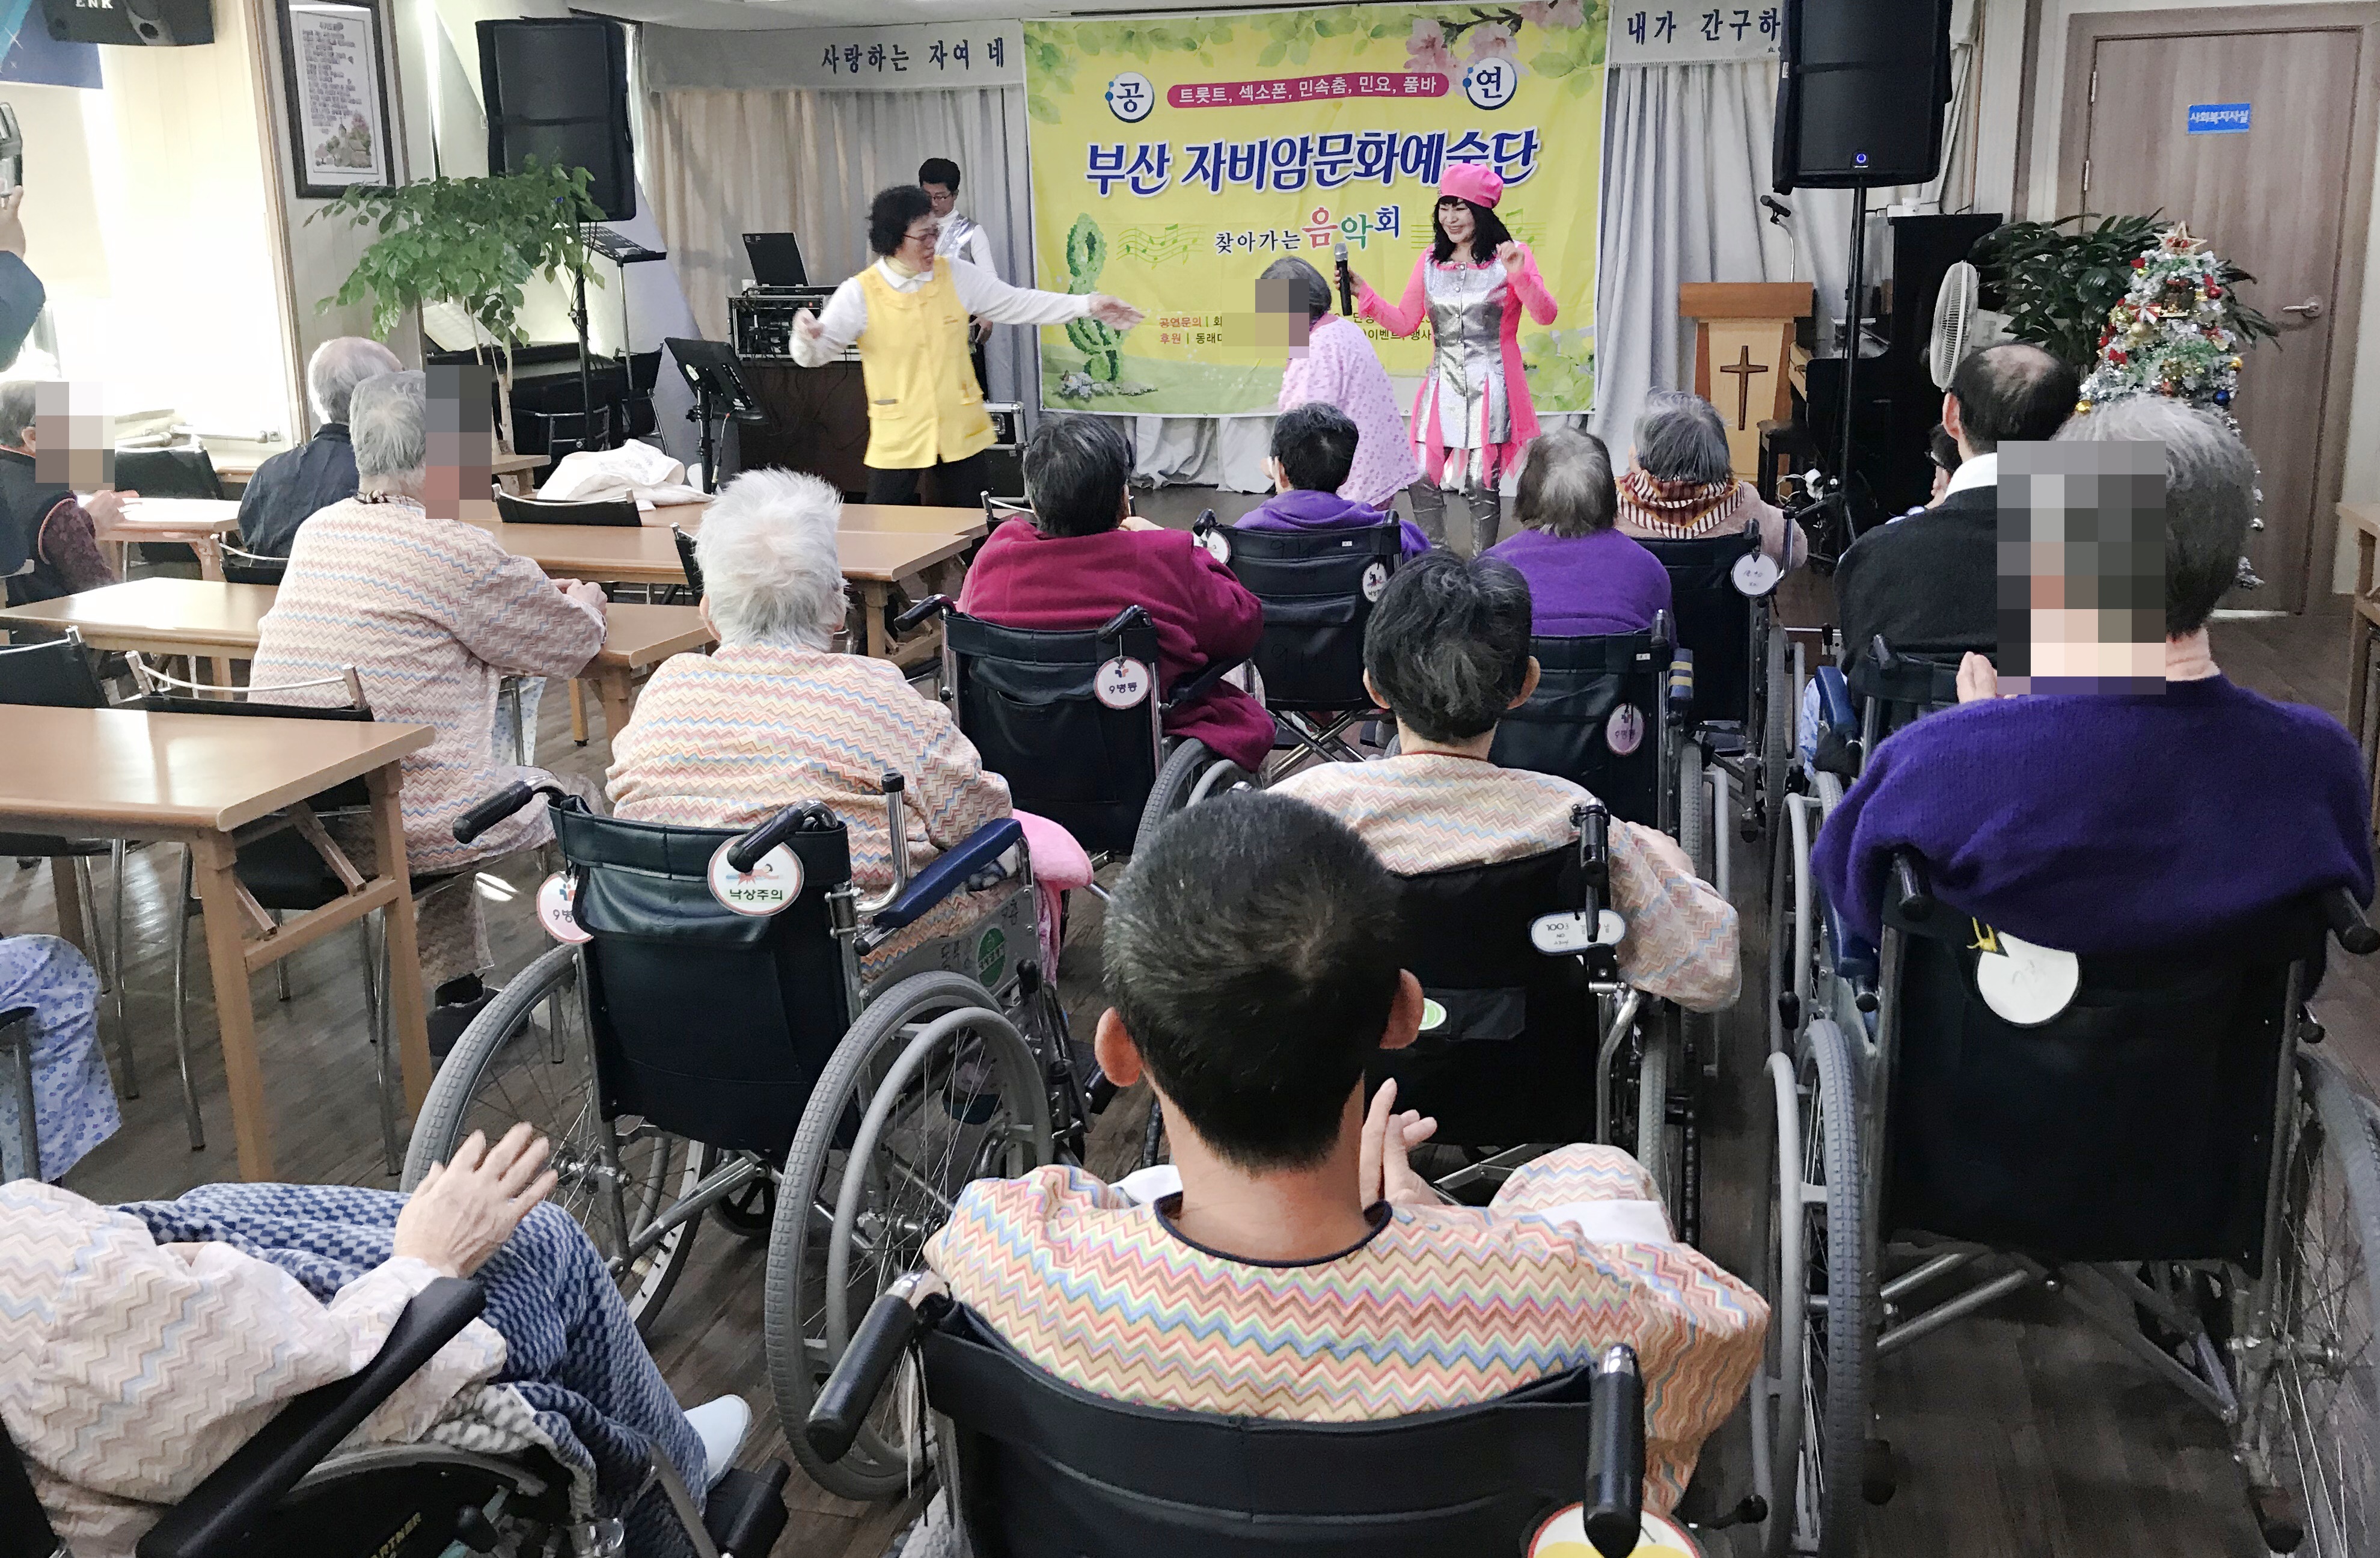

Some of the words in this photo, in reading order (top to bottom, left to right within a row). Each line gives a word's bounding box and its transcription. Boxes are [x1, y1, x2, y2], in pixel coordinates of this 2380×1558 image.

[1627, 10, 1677, 45] 내가
[1700, 7, 1781, 41] 간구하
[821, 43, 910, 75] 사랑하는
[929, 40, 970, 71] 자여
[987, 37, 1005, 68] 네
[1116, 82, 1145, 113] 공
[1179, 87, 1233, 104] 트롯트,
[1238, 83, 1292, 102] 섹소폰,
[1299, 76, 1353, 98] 민속춤,
[1359, 75, 1396, 94] 민요,
[1403, 75, 1437, 94] 품바
[1476, 66, 1503, 99] 연
[1085, 141, 1172, 197] 부산
[1180, 127, 1540, 194] 자비암문화예술단
[1215, 230, 1301, 254] 찾아가는
[1302, 205, 1400, 250] 음악회
[1159, 316, 1202, 328] 공연문의
[1159, 333, 1181, 345] 후원
[1196, 333, 1222, 345] 동래
[1109, 681, 1137, 695] 9병동
[729, 889, 783, 901] 낙상주의
